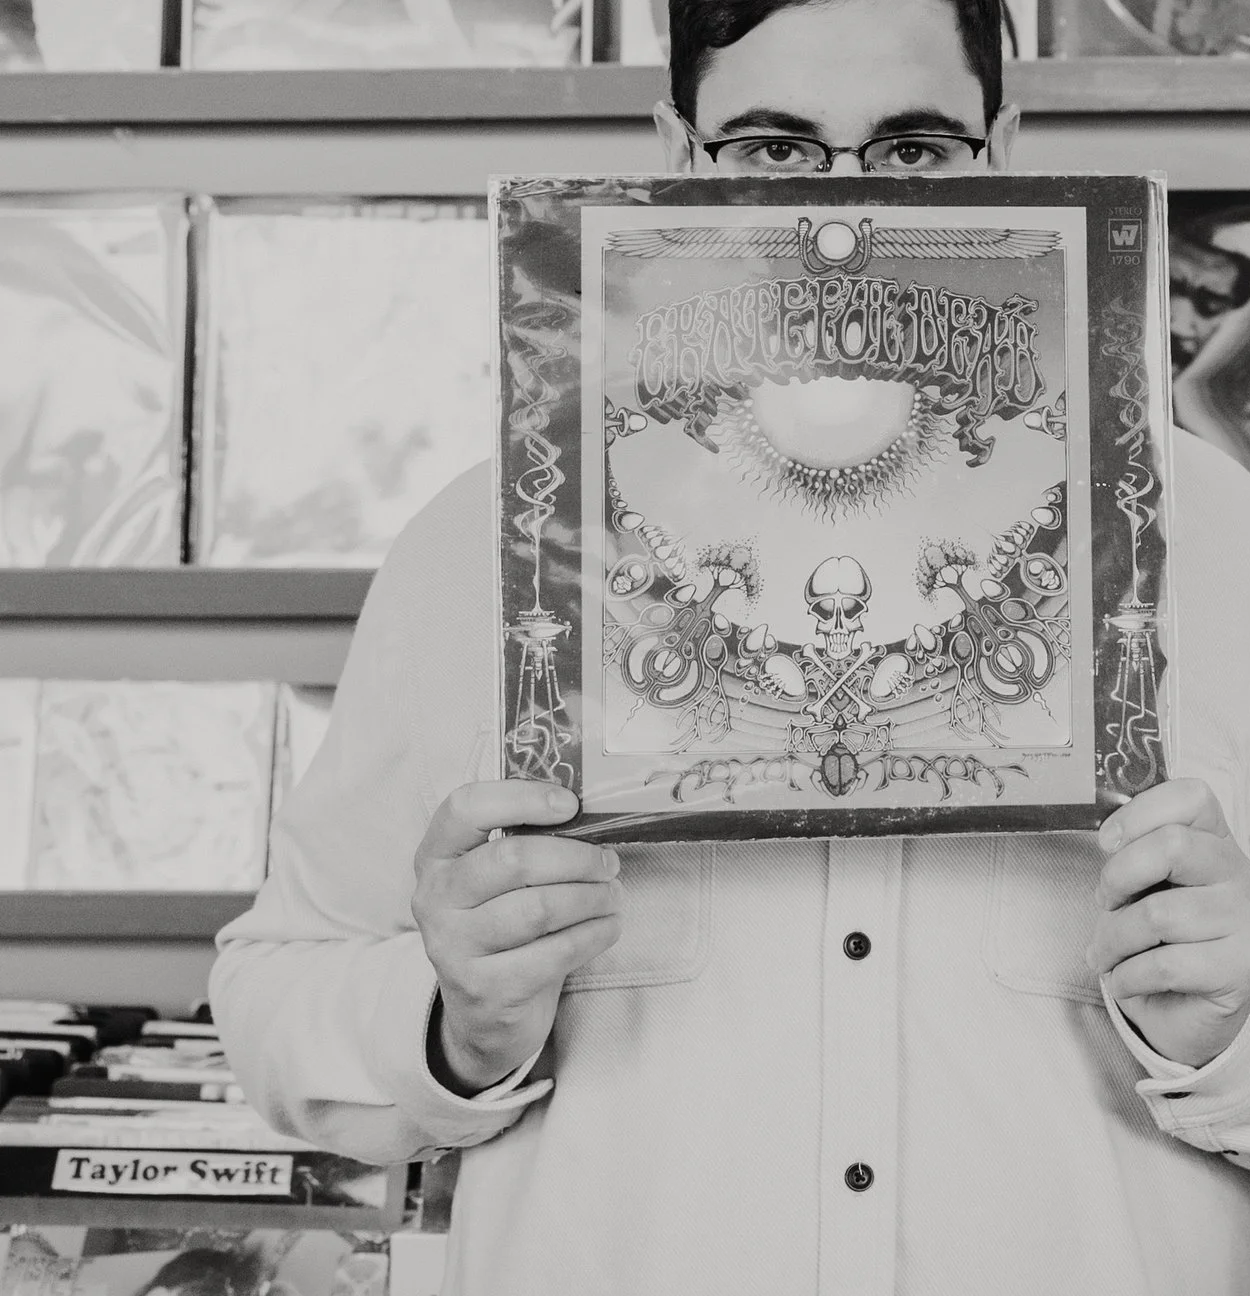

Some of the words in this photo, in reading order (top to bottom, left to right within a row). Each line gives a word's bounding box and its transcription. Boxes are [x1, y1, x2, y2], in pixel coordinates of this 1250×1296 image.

[1108, 206, 1143, 216] STEREO
[1111, 255, 1141, 266] 1790
[634, 275, 903, 412] GRATEFUL
[903, 279, 1047, 416] DEAD
[69, 1157, 178, 1185] Taylor
[189, 1159, 284, 1186] Swift
